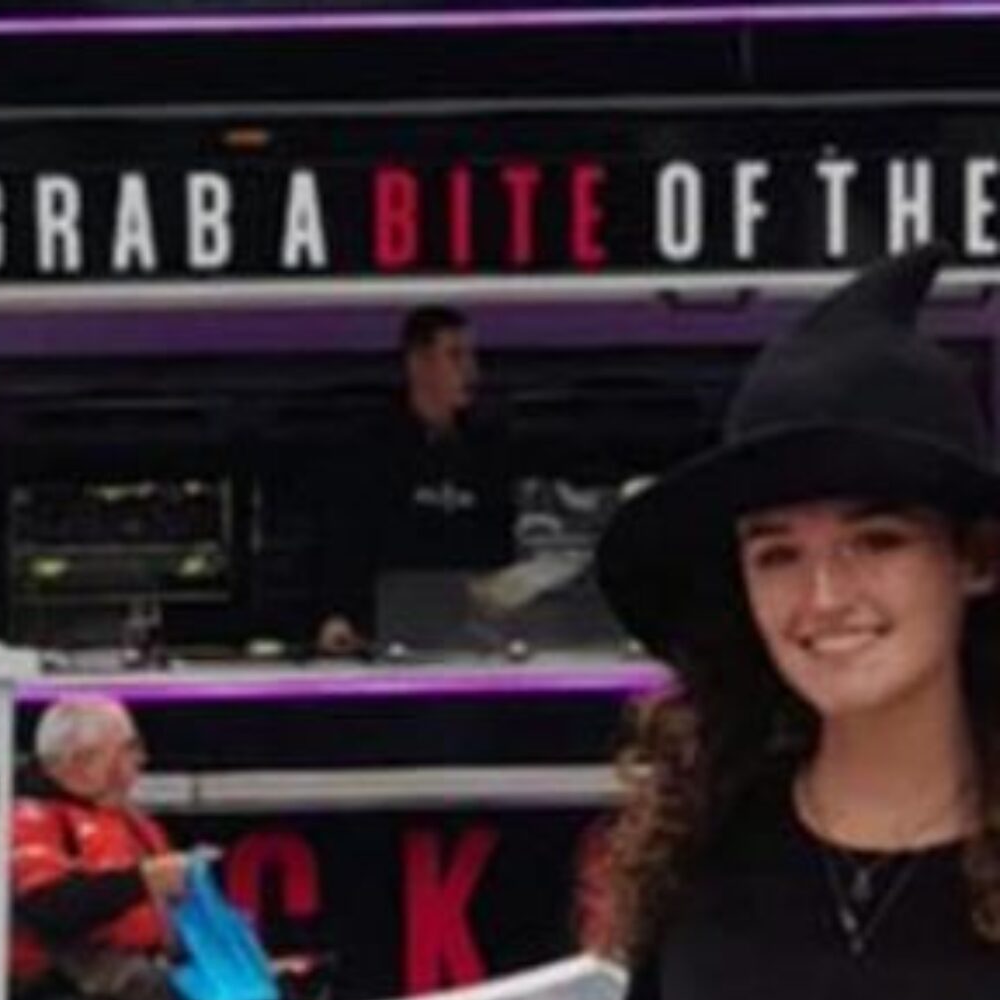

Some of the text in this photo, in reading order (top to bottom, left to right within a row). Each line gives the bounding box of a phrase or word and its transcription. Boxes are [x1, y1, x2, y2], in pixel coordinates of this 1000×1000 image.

[281, 170, 327, 269] A
[374, 165, 607, 268] BITE
[658, 160, 769, 260] OF
[815, 157, 1000, 258] THE
